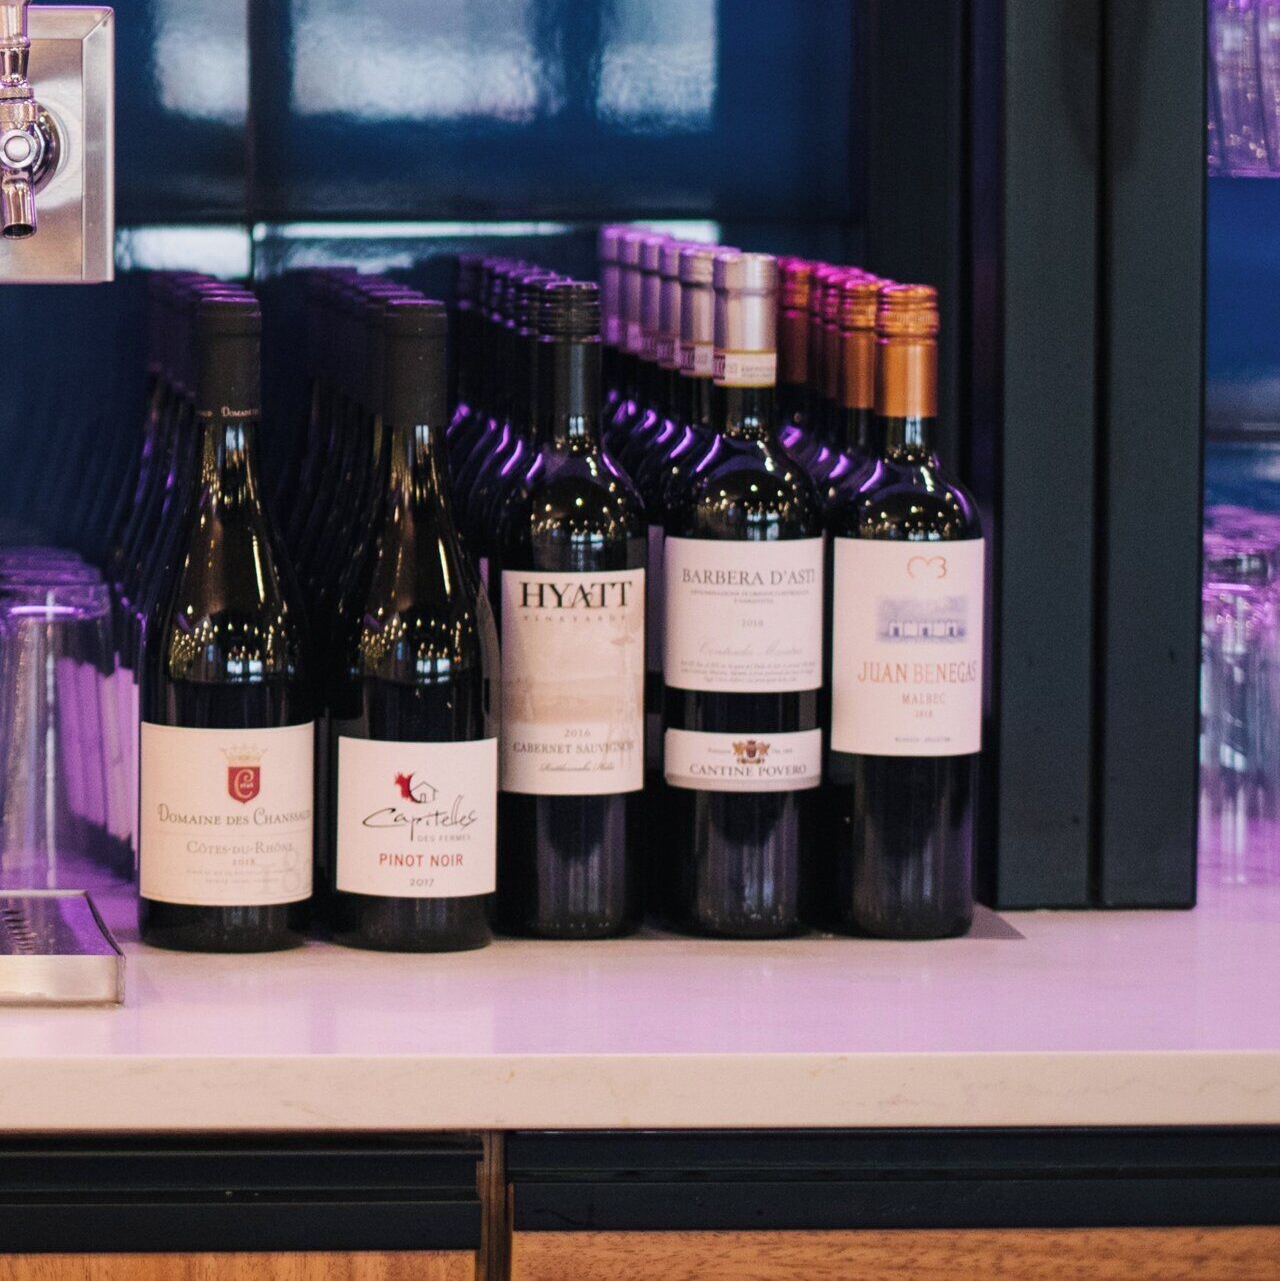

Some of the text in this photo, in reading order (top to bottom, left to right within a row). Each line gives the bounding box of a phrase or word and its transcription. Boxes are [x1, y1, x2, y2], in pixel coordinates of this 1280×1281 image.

[681, 567, 816, 586] BARBERA D'ASTI
[519, 580, 633, 609] HYATT
[857, 660, 978, 684] JUAN BENEGAS
[901, 693, 946, 705] MALBEC
[563, 727, 592, 738] 2016
[512, 741, 572, 754] CABERNET
[689, 762, 808, 777] CANTINE POVERO
[157, 803, 222, 826] DOMAINE
[226, 814, 250, 826] DES
[379, 852, 464, 868] PINOT NOIR
[409, 877, 435, 888] 2017
